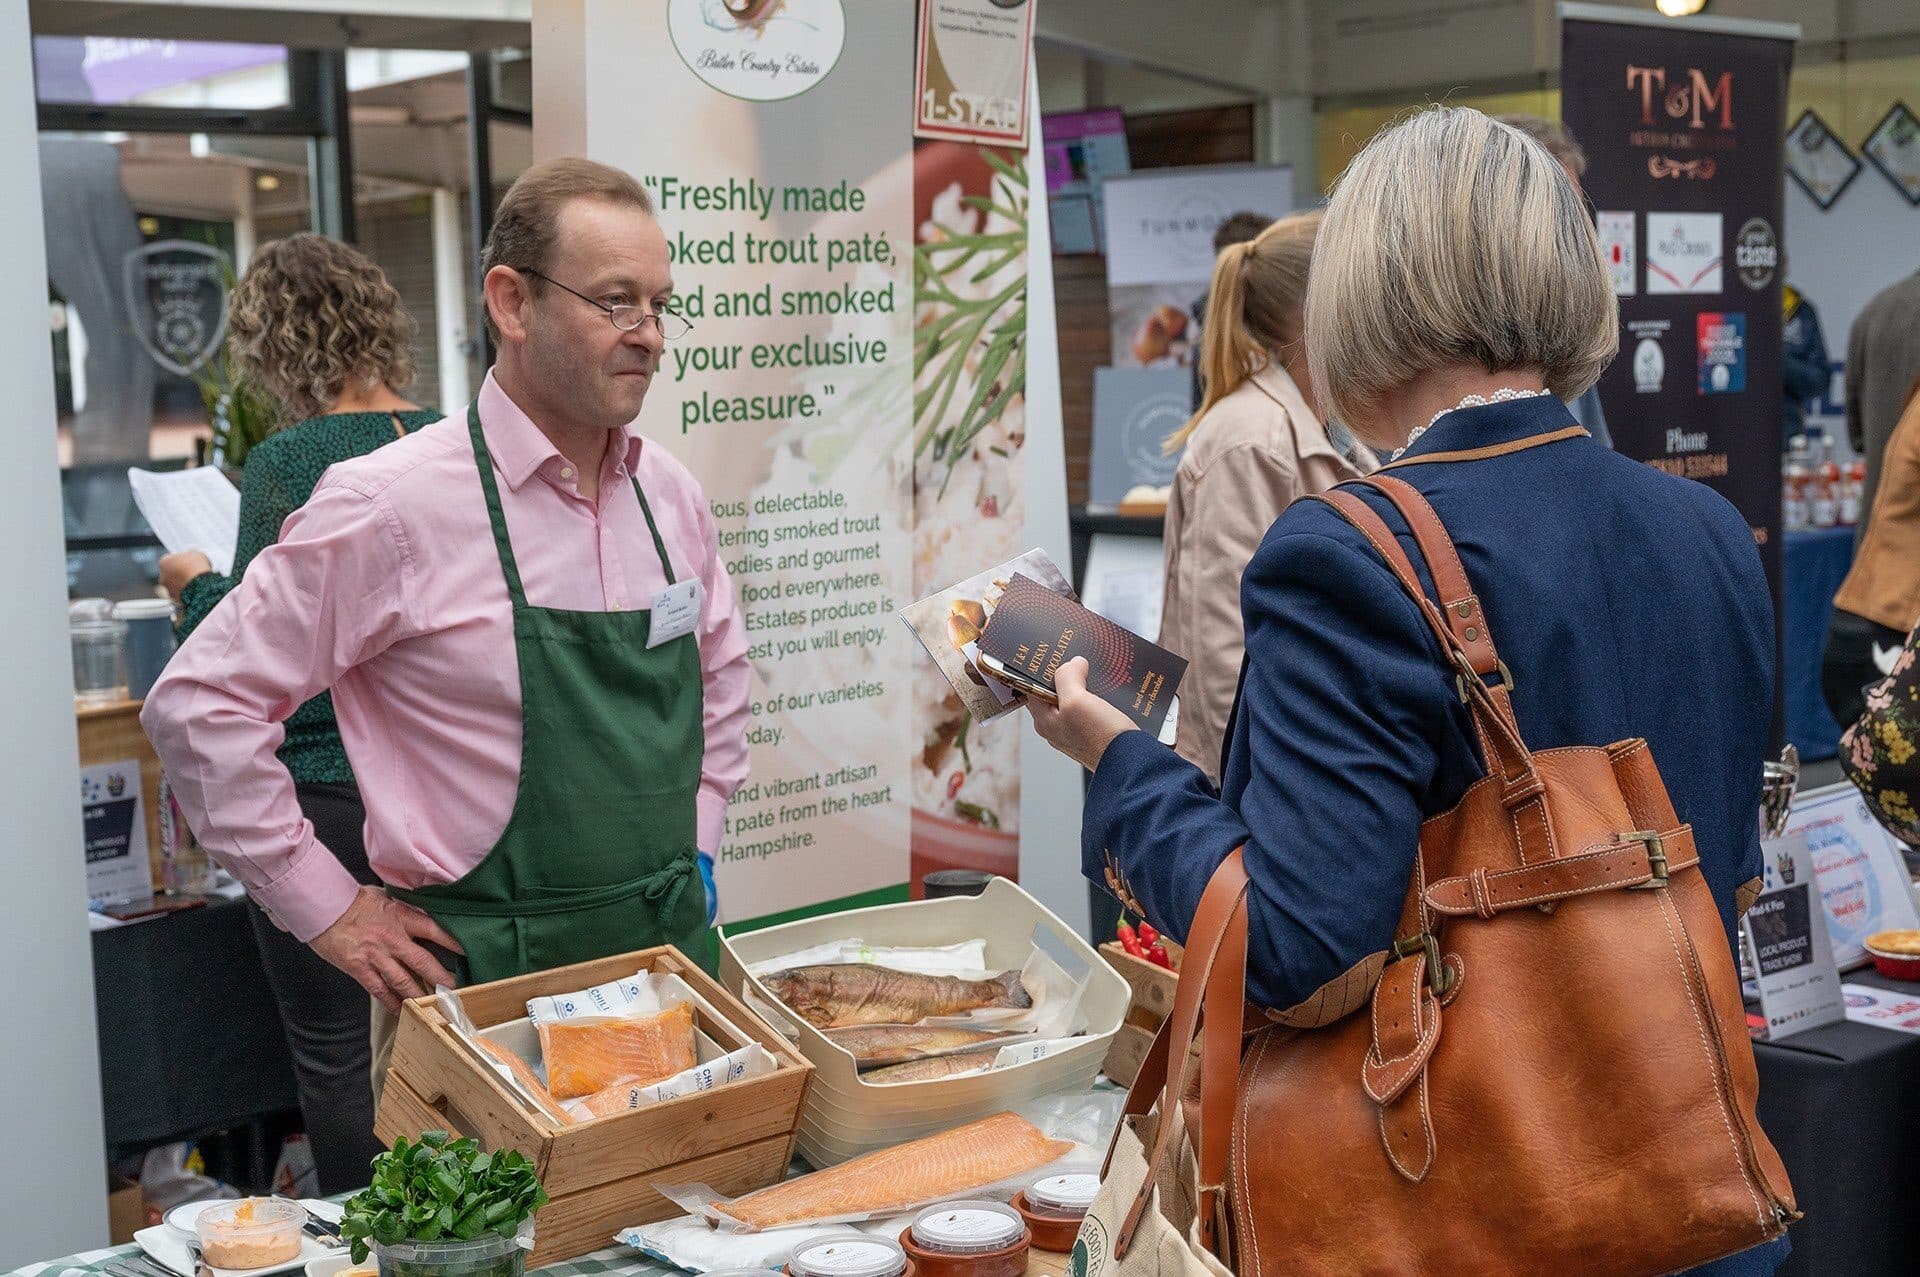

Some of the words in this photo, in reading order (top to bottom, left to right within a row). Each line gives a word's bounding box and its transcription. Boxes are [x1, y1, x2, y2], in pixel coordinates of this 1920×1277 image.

[783, 179, 866, 213] made
[744, 232, 819, 264] trout
[827, 231, 897, 273] paté,
[713, 283, 772, 317] and
[780, 281, 896, 316] smoked
[674, 343, 744, 382] your
[750, 332, 888, 369] exclusive
[753, 489, 848, 515] delectable,
[718, 525, 769, 549] tering
[773, 517, 839, 542] smoked
[843, 513, 881, 534] trout
[725, 553, 773, 576] odies
[777, 548, 808, 571] and
[812, 541, 881, 571] gourmet
[740, 580, 781, 604] food
[785, 571, 884, 599] everywhere.
[744, 610, 808, 632] Estates
[810, 600, 878, 627] produce
[880, 594, 894, 613] is
[747, 640, 774, 661] est
[777, 637, 808, 662] you
[811, 628, 840, 650] will
[842, 625, 888, 649] enjoy.
[1028, 640, 1050, 675] ARTISAN
[1042, 627, 1074, 682] CHOCOLATES
[766, 693, 784, 714] of
[787, 692, 814, 711] our
[817, 680, 885, 706] varieties
[727, 783, 761, 806] and
[763, 771, 821, 799] vibrant
[824, 762, 878, 788] artisan
[779, 803, 819, 825] from
[821, 795, 849, 816] the
[851, 784, 892, 810] heart
[721, 831, 817, 864] Hampshire.
[1086, 1227, 1102, 1260] FOOD
